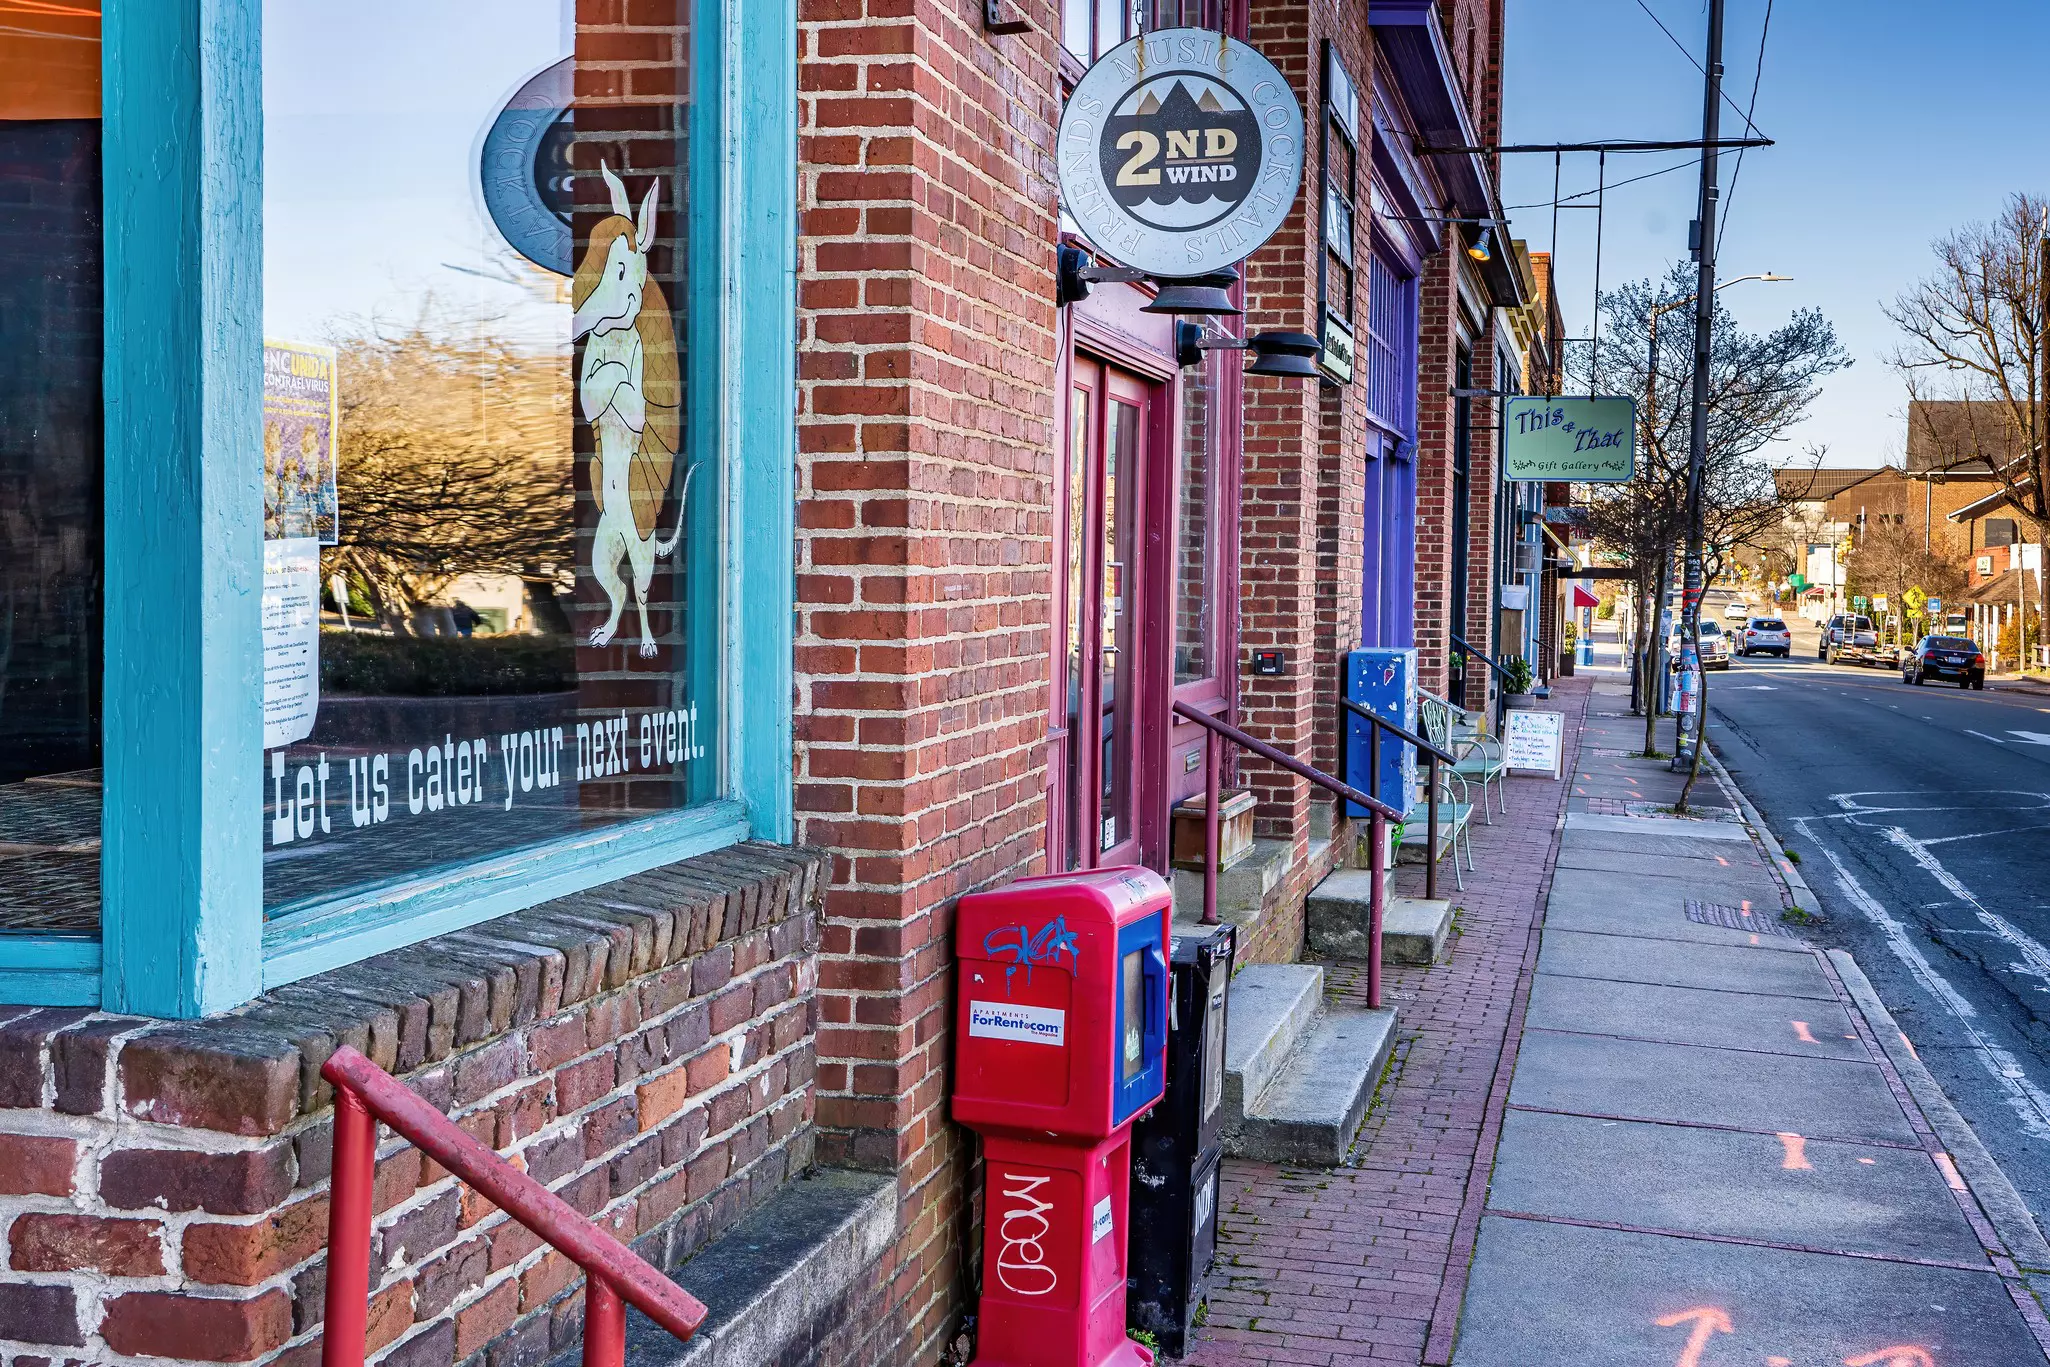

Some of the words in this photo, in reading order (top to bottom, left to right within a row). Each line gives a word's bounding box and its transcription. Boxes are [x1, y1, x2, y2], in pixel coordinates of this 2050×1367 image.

[1111, 35, 1241, 84] MUSIC
[1066, 92, 1147, 257] FRIENDS
[1165, 164, 1238, 184] WIND
[1184, 80, 1296, 265] COCKTAILS
[1515, 406, 1565, 435] This
[1573, 426, 1625, 454] That
[1537, 461, 1557, 471] Gift
[1561, 461, 1600, 473] Gallery
[271, 748, 332, 845] Let
[350, 752, 389, 827] us
[407, 732, 488, 817] cater
[501, 724, 563, 811] your
[576, 708, 629, 779] next
[640, 700, 705, 770] event.
[973, 1009, 1029, 1019] APARTMENTS
